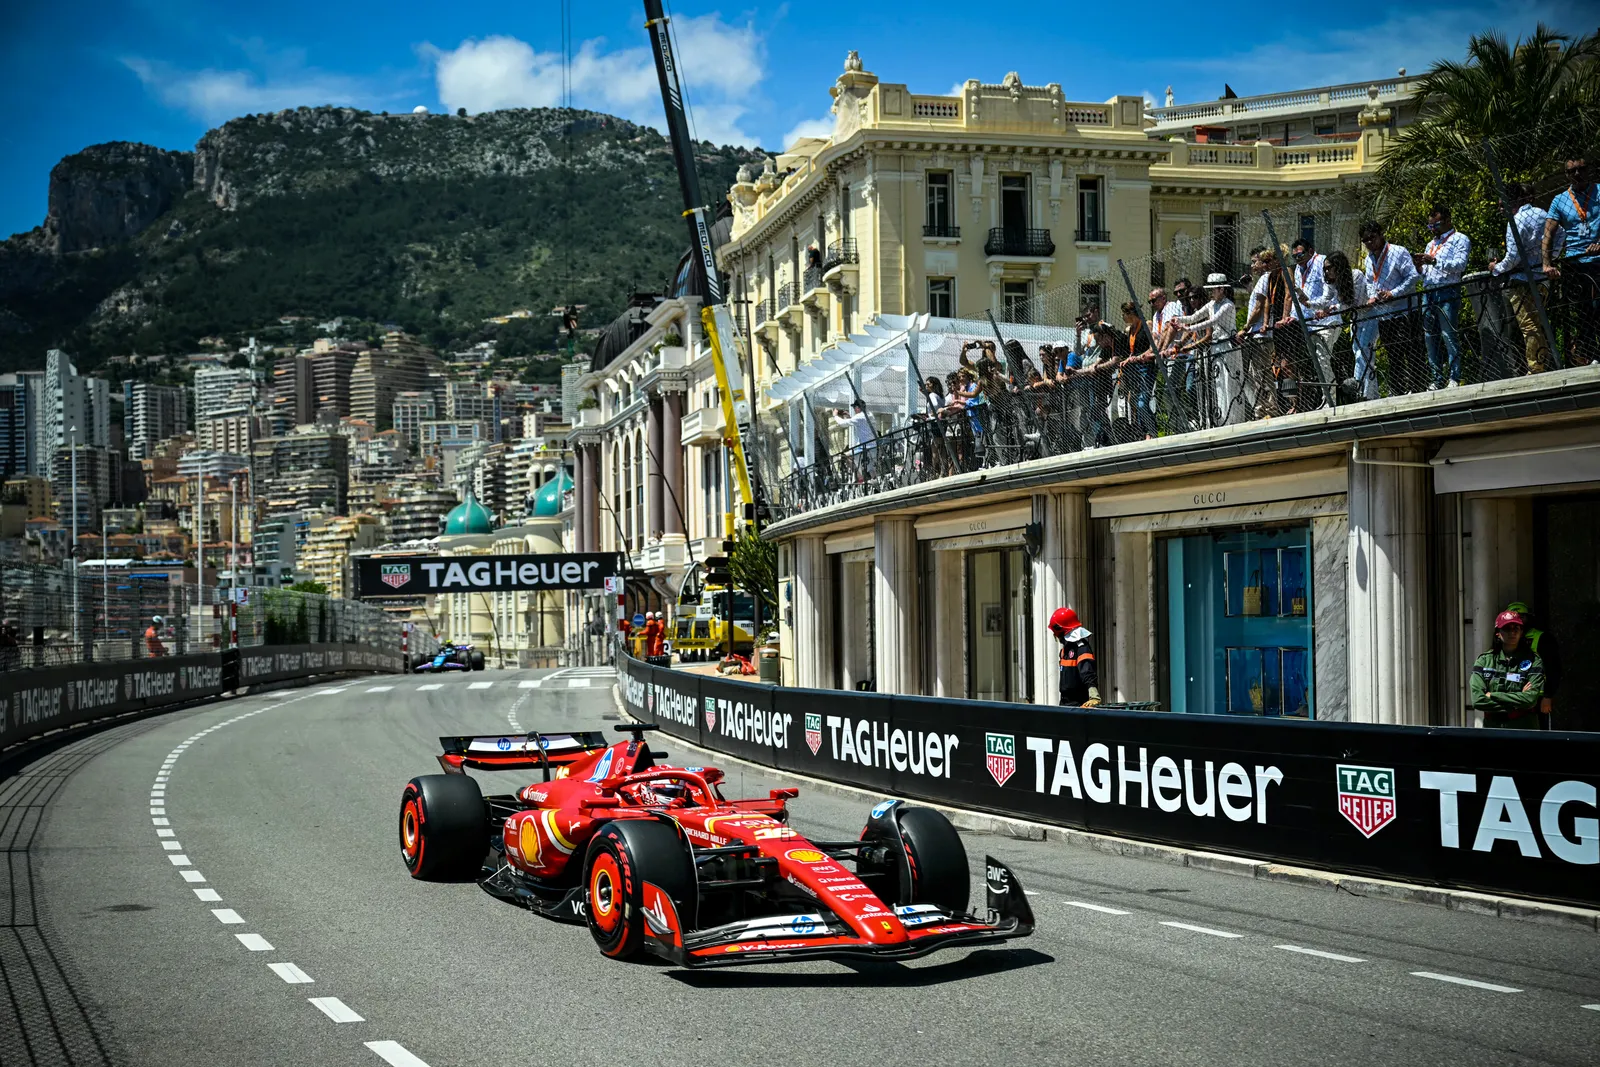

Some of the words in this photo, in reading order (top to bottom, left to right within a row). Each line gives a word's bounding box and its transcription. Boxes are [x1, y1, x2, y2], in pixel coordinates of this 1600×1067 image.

[698, 222, 712, 268] MEDIACO
[1193, 492, 1226, 505] GUCCI
[383, 566, 408, 574] TAG
[383, 575, 408, 586] HEUER
[806, 715, 820, 730] TAG
[497, 738, 511, 750] hp
[988, 737, 1012, 754] TAG
[988, 756, 1014, 782] HEUER
[1341, 769, 1390, 794] TAG
[1341, 796, 1392, 832] HEUER
[685, 827, 709, 841] RICHARD
[614, 841, 632, 895] ZERO
[986, 865, 1009, 883] aws
[742, 942, 806, 951] V-Power
